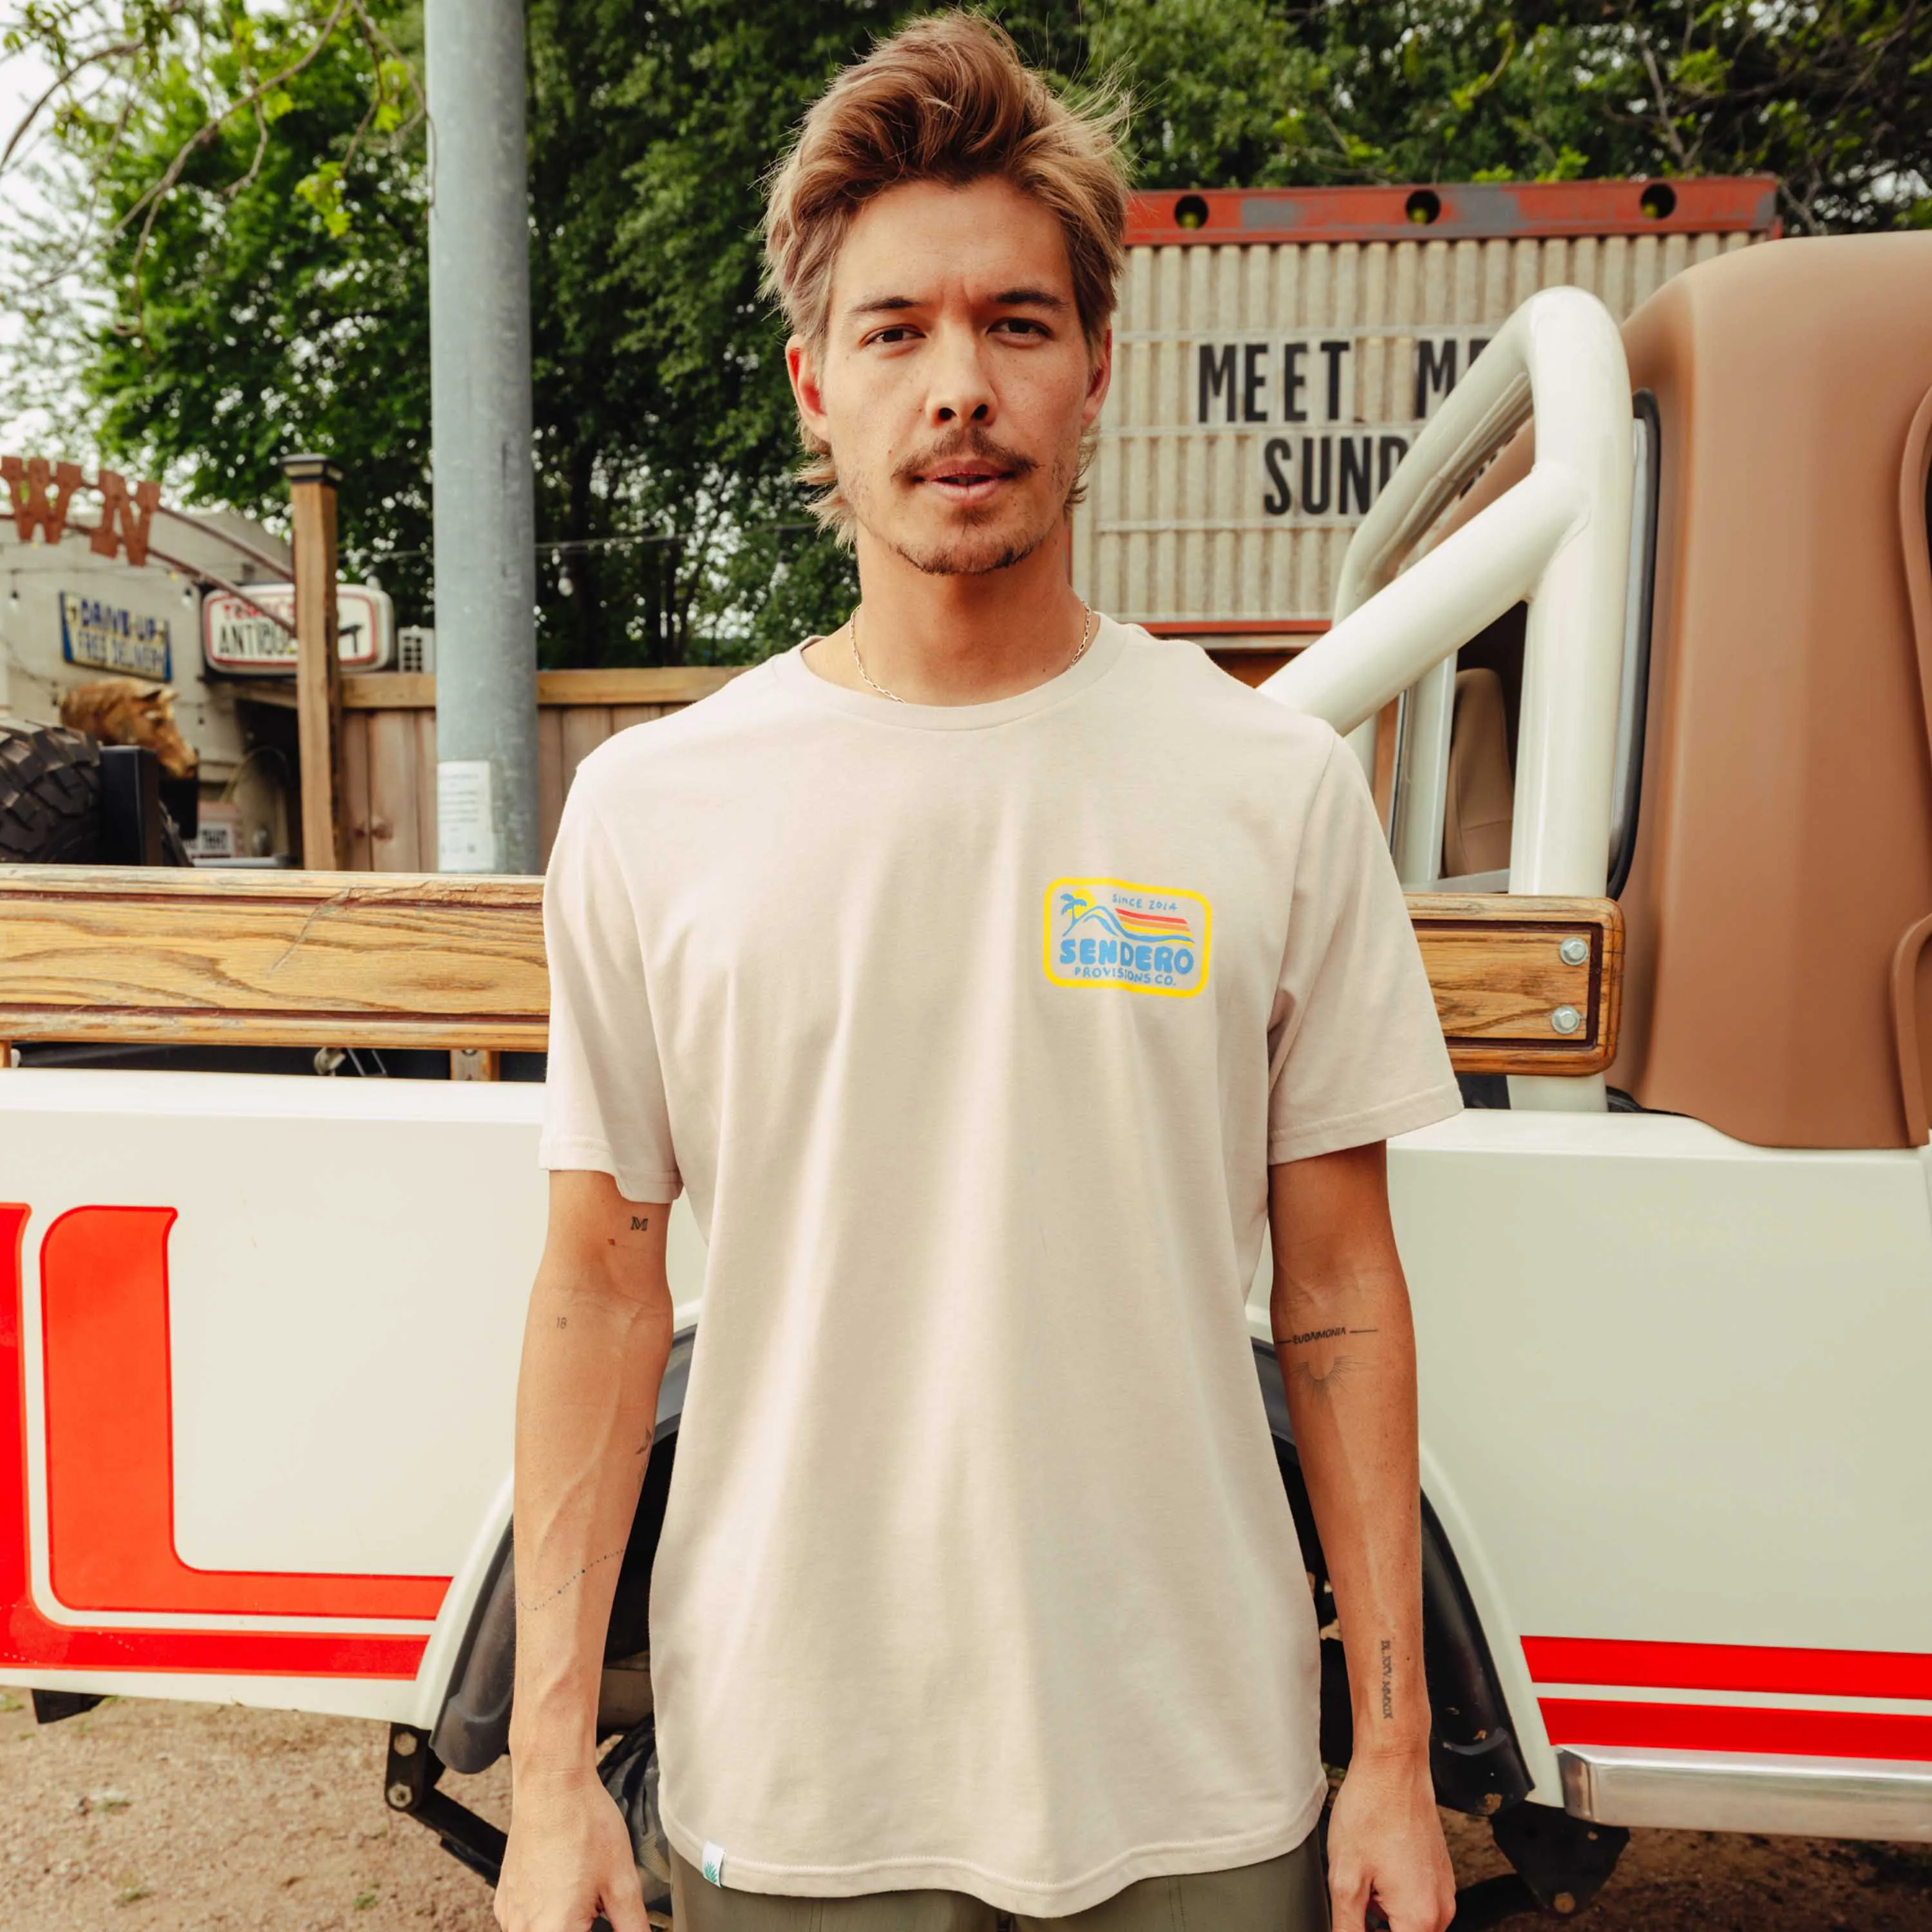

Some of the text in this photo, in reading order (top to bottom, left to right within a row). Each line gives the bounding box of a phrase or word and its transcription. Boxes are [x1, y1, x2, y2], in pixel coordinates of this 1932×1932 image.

[1198, 339, 1490, 423] MEET M
[1148, 900, 1179, 911] 2014
[1059, 938, 1195, 975] SENDERO
[1074, 966, 1177, 987] PROVISIONS CO.
[630, 1215, 649, 1232] M
[556, 1316, 567, 1329] 18
